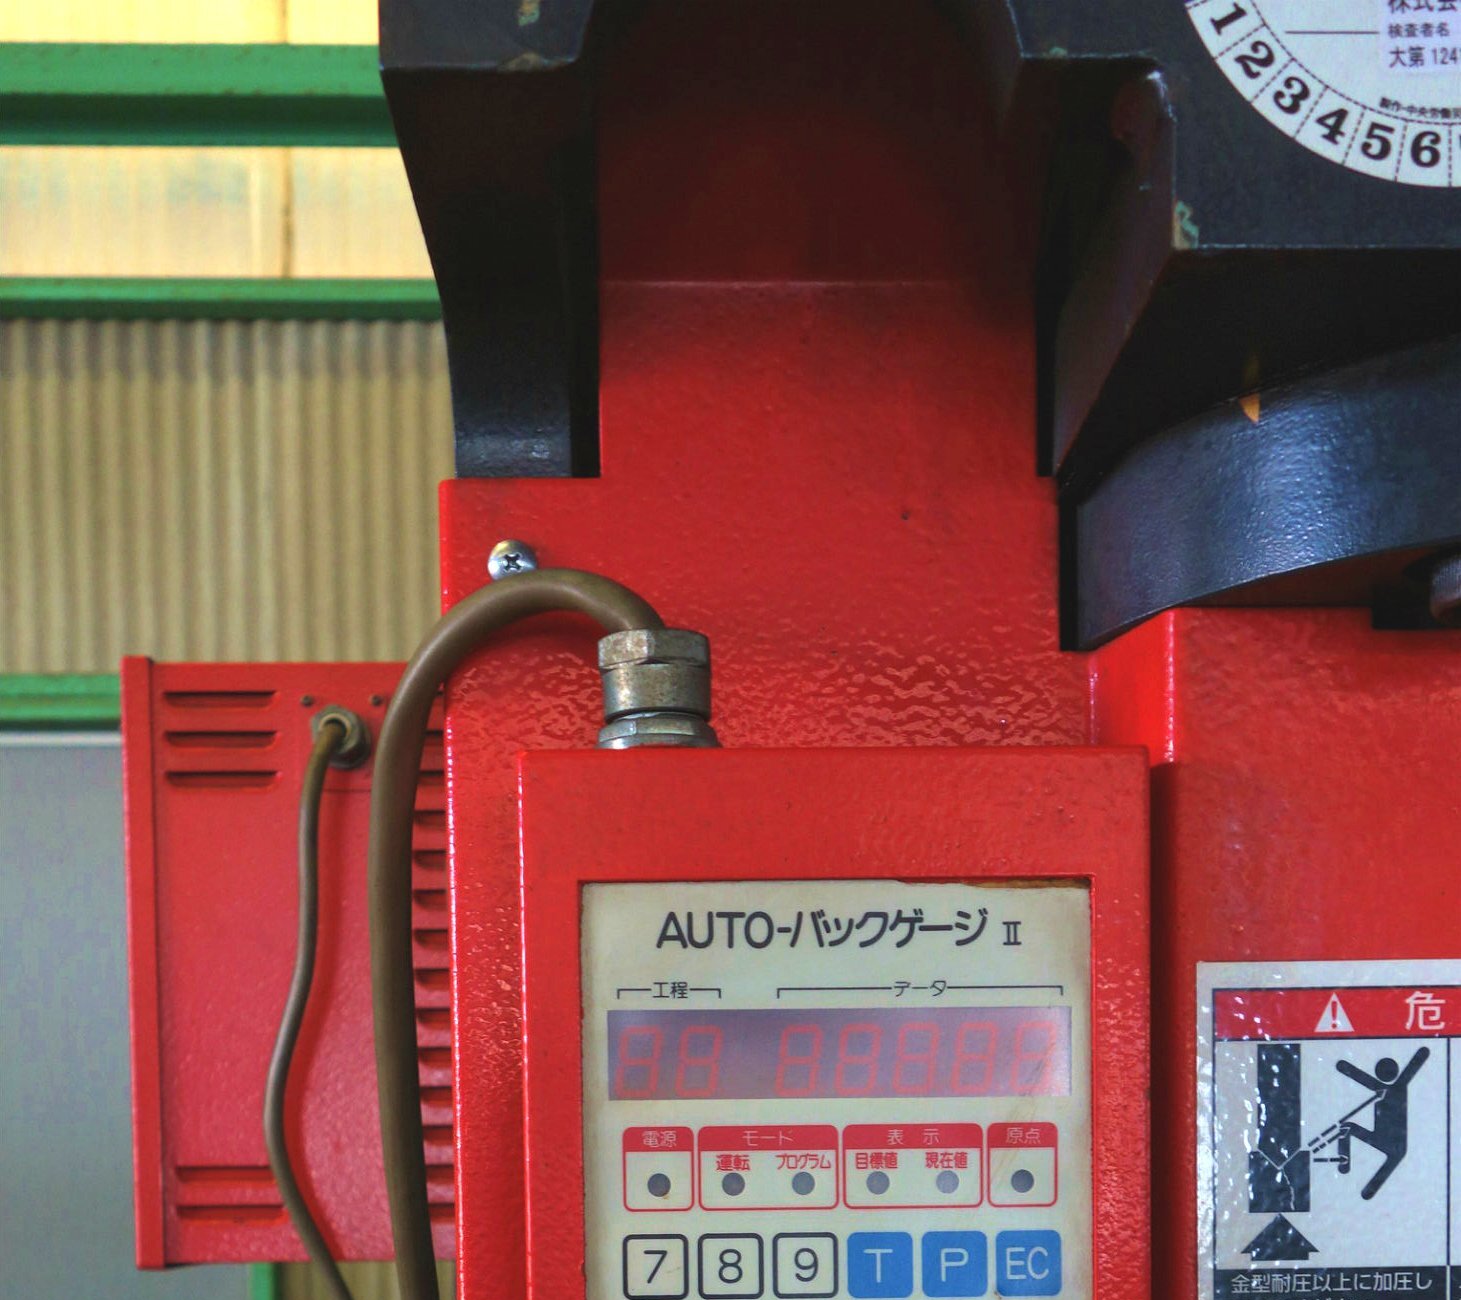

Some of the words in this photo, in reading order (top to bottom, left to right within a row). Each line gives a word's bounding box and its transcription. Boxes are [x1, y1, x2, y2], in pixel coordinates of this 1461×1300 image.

[1388, 22, 1450, 38] 検査者名
[1432, 47, 1461, 65] 124
[1210, 2, 1247, 36] 1
[1234, 41, 1275, 79] 2
[1273, 76, 1310, 114] 3
[1316, 108, 1349, 145] 4
[1361, 122, 1395, 161] 5
[1410, 131, 1441, 168] 6
[656, 908, 988, 949] AUTO-バックゲージ
[652, 981, 688, 999] 工程
[894, 981, 947, 998] データ
[1405, 991, 1446, 1030] 危
[642, 1130, 677, 1148] 電源
[742, 1130, 793, 1146] モード
[1005, 1127, 1041, 1145] 原点
[716, 1154, 750, 1171] 運転
[775, 1153, 831, 1170] プログラム
[855, 1152, 898, 1170] 目標値
[925, 1152, 968, 1169] 現在値
[644, 1249, 668, 1285] 7
[718, 1248, 743, 1283] 8
[793, 1247, 819, 1283] 9
[863, 1248, 893, 1283] T
[940, 1247, 969, 1282] P
[1005, 1246, 1050, 1281] EC
[1231, 1272, 1432, 1294] 金型耐圧以上に加圧し
